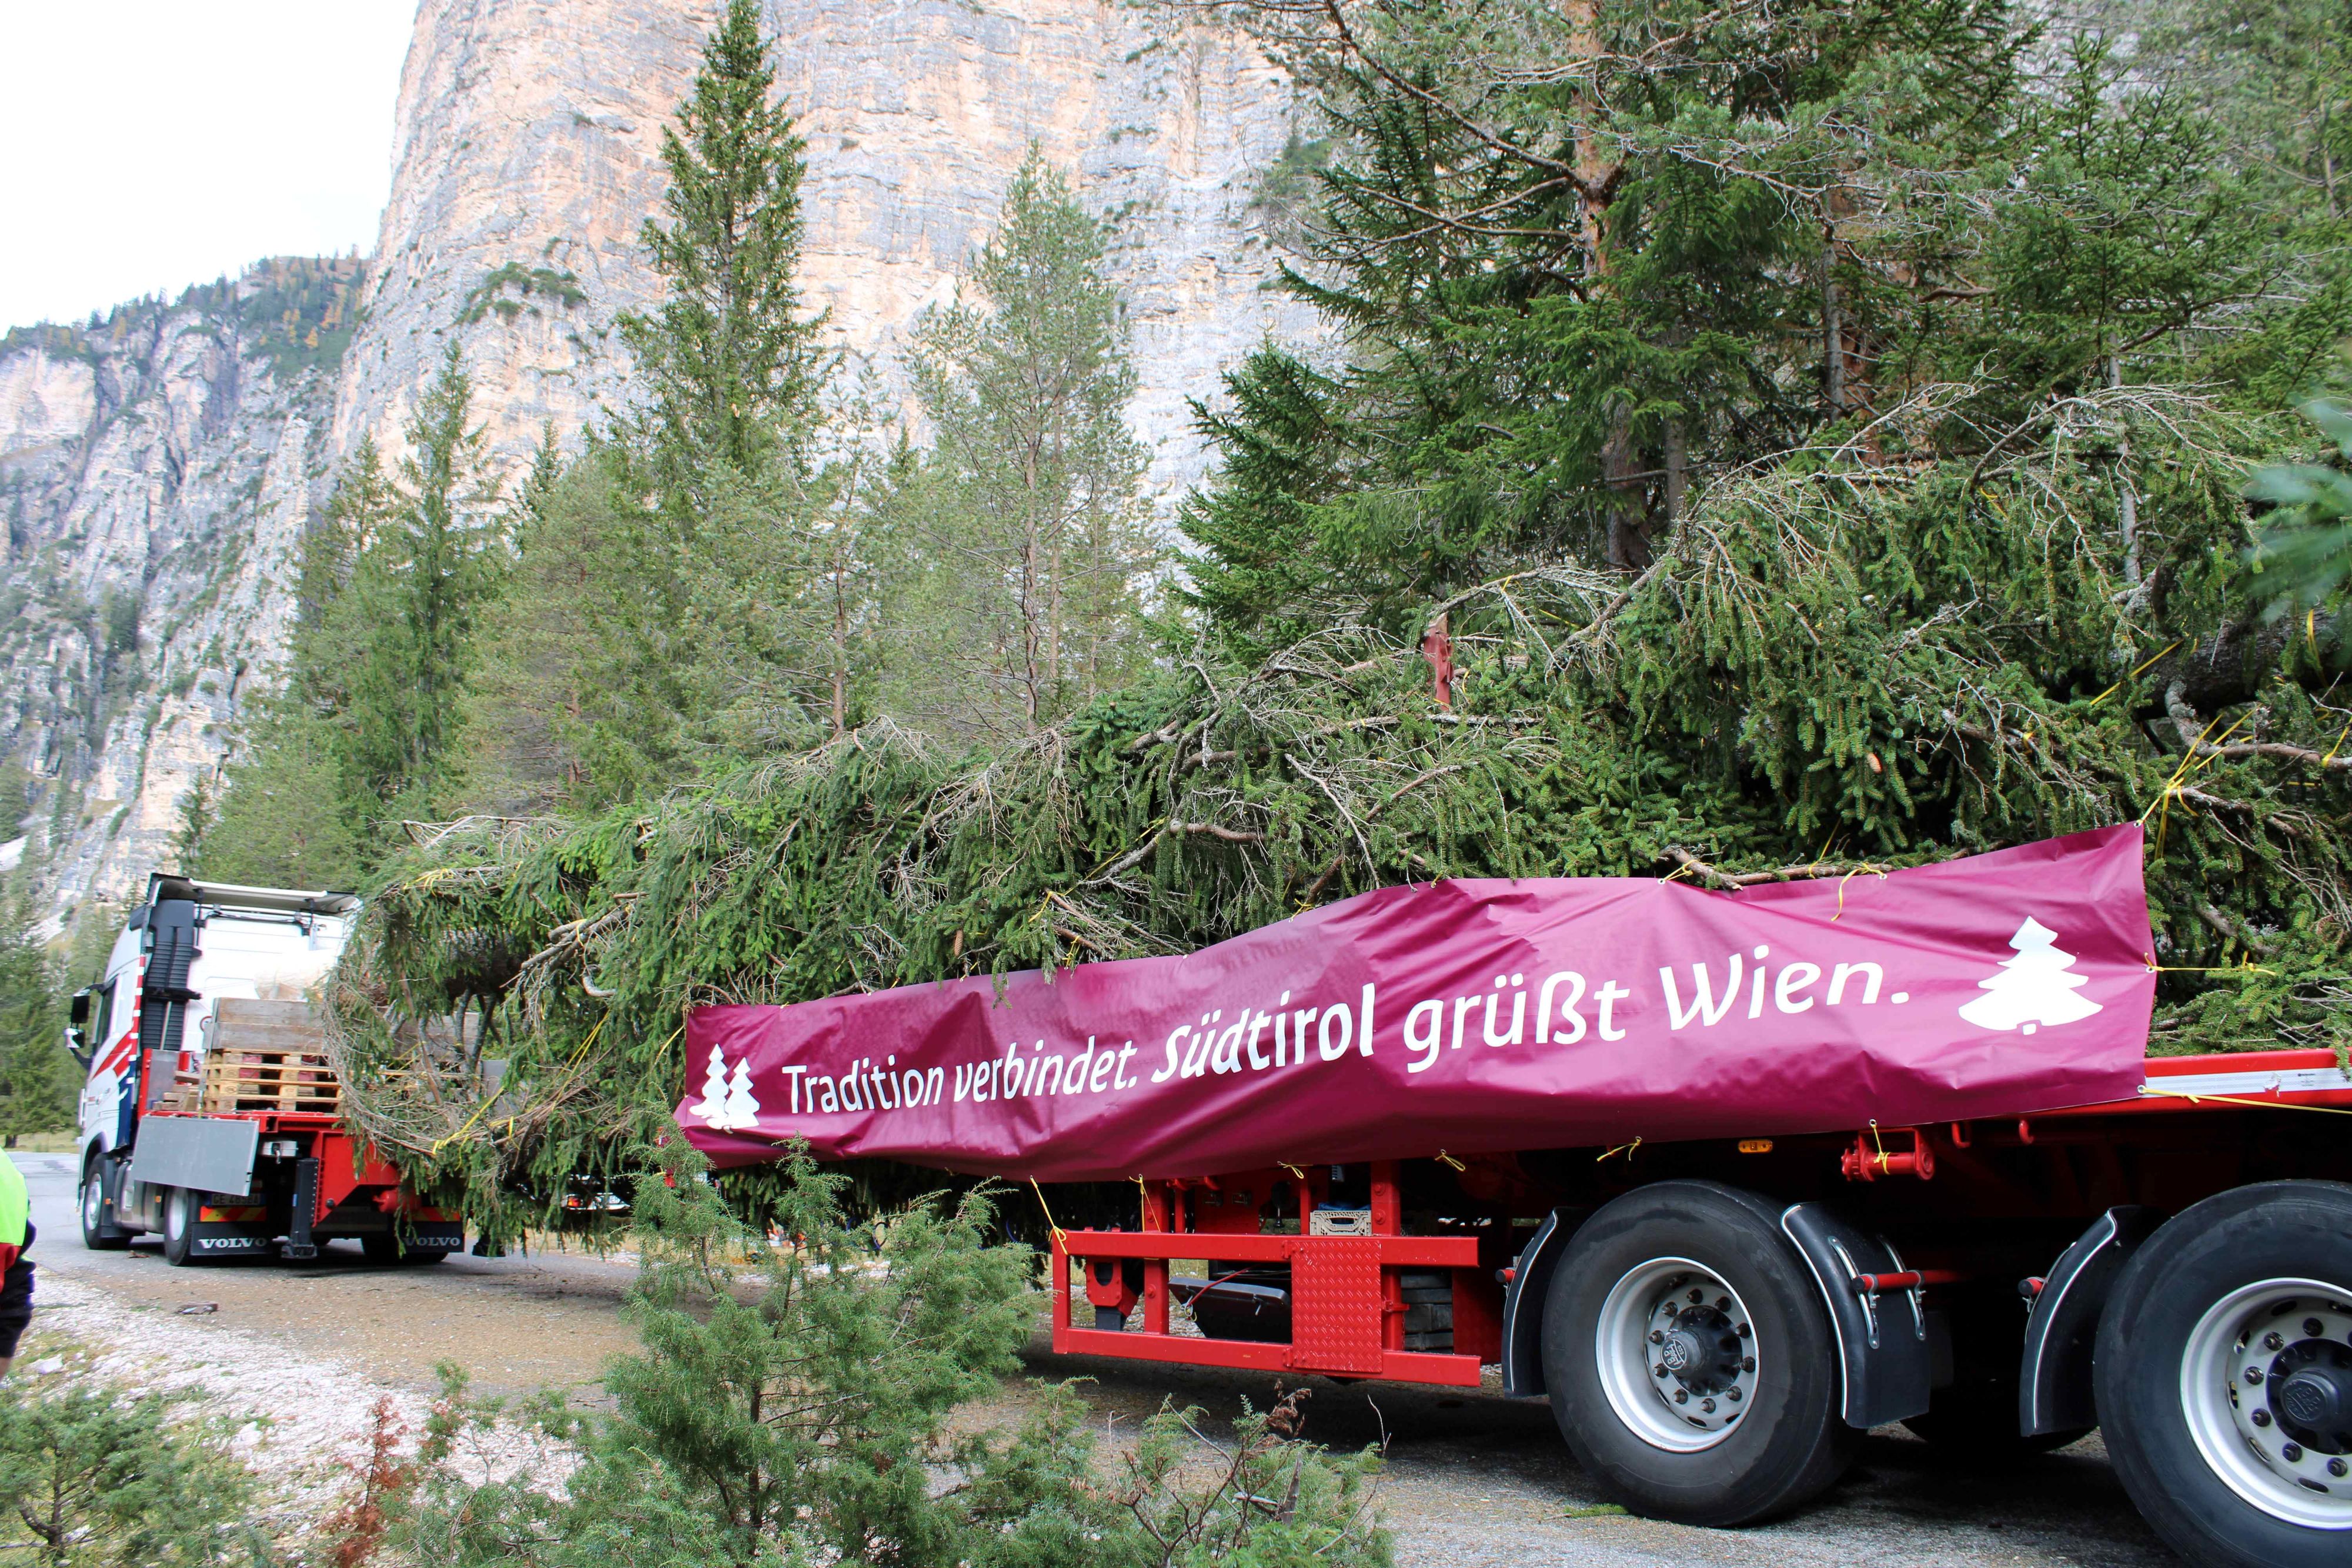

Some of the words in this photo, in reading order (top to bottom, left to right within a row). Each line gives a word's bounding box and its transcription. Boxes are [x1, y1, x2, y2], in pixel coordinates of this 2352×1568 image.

[781, 1054, 944, 1114] Tradition
[953, 1034, 1138, 1102] verbindet.
[1150, 982, 1375, 1084] Südtirol
[1403, 971, 1631, 1073] grüßt
[1658, 944, 1910, 1031] Wien.
[198, 1238, 268, 1248] VOLVO
[402, 1237, 460, 1246] VOLVO
